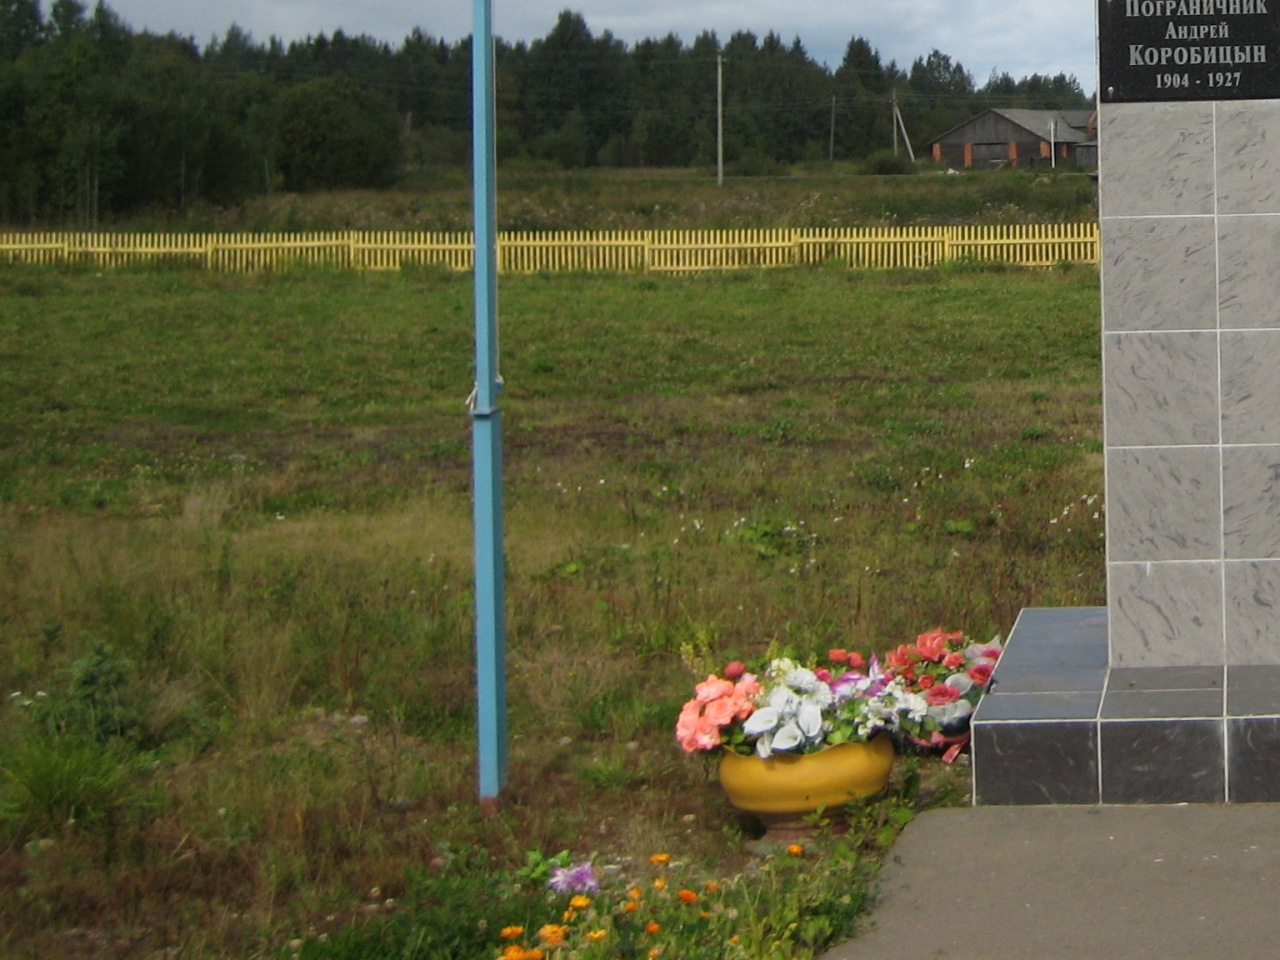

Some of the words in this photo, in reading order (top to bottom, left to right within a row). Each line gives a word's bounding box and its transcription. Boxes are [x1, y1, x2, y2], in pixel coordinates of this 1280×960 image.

[1164, 21, 1229, 41] АНДРЕЙ
[1129, 44, 1267, 67] КОРОБИЦЫН
[1156, 73, 1190, 89] 1904
[1207, 72, 1241, 88] 1927
